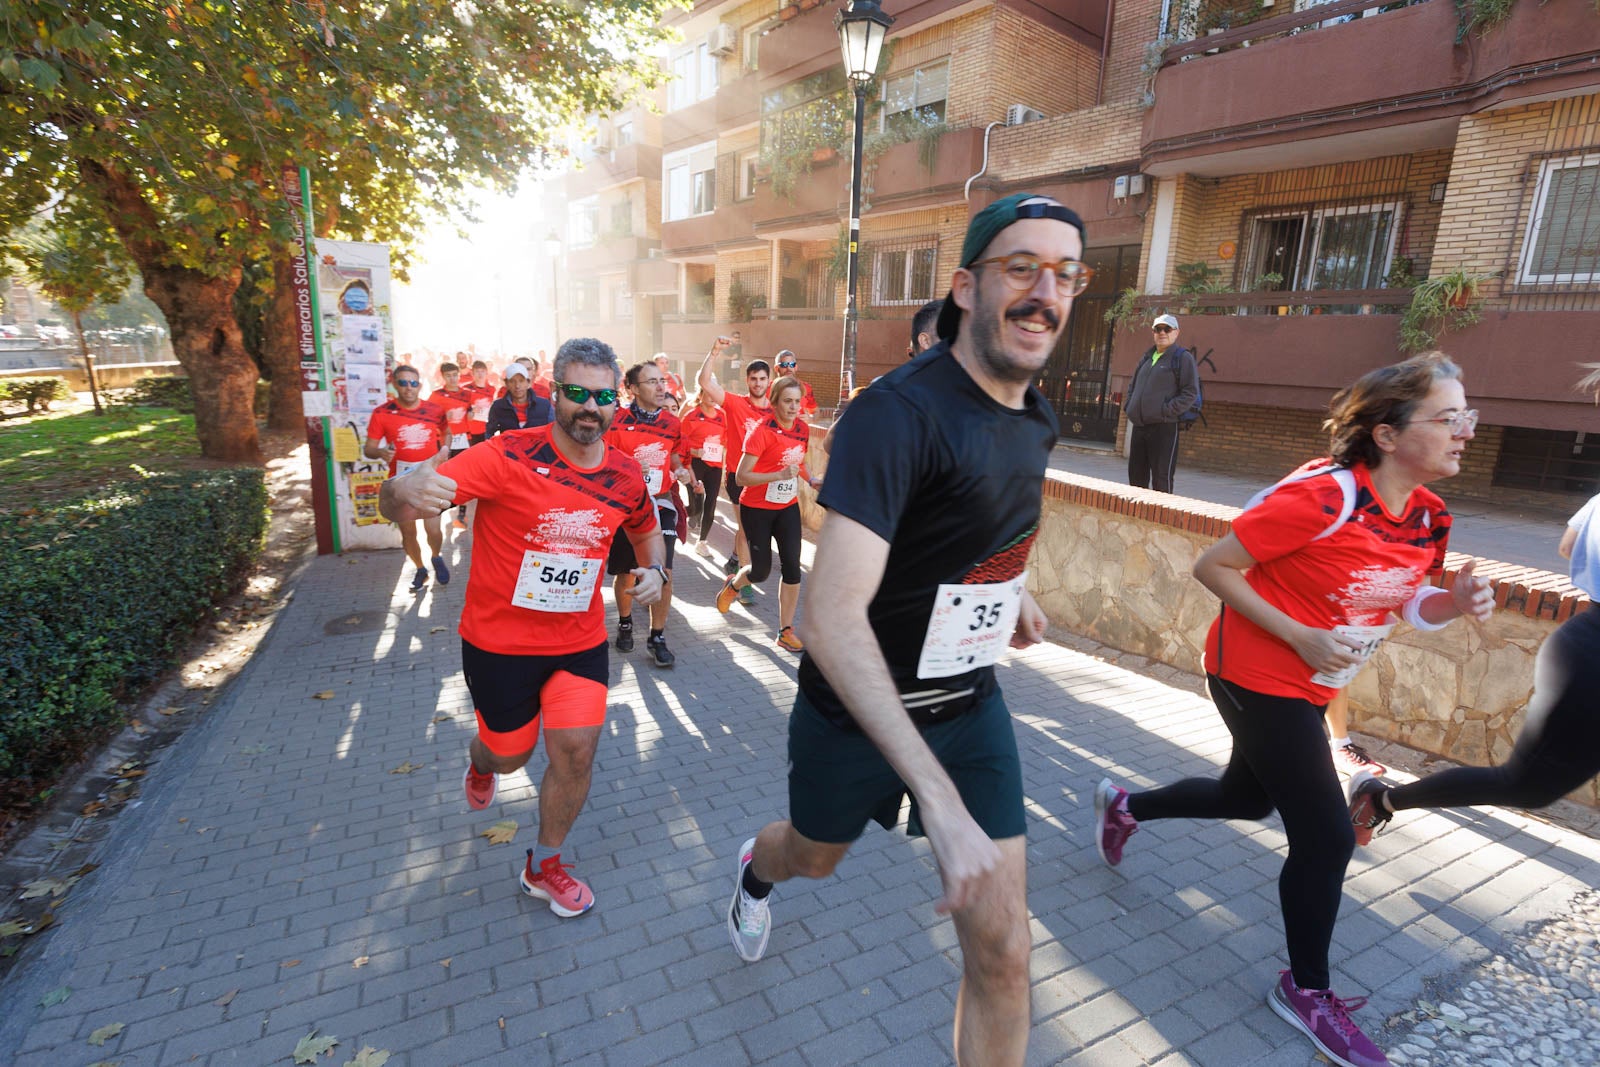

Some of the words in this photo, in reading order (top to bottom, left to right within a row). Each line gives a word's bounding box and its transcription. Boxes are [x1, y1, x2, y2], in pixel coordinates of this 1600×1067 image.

[777, 483, 793, 492] 634
[540, 566, 580, 586] 546
[969, 602, 1003, 631] 35
